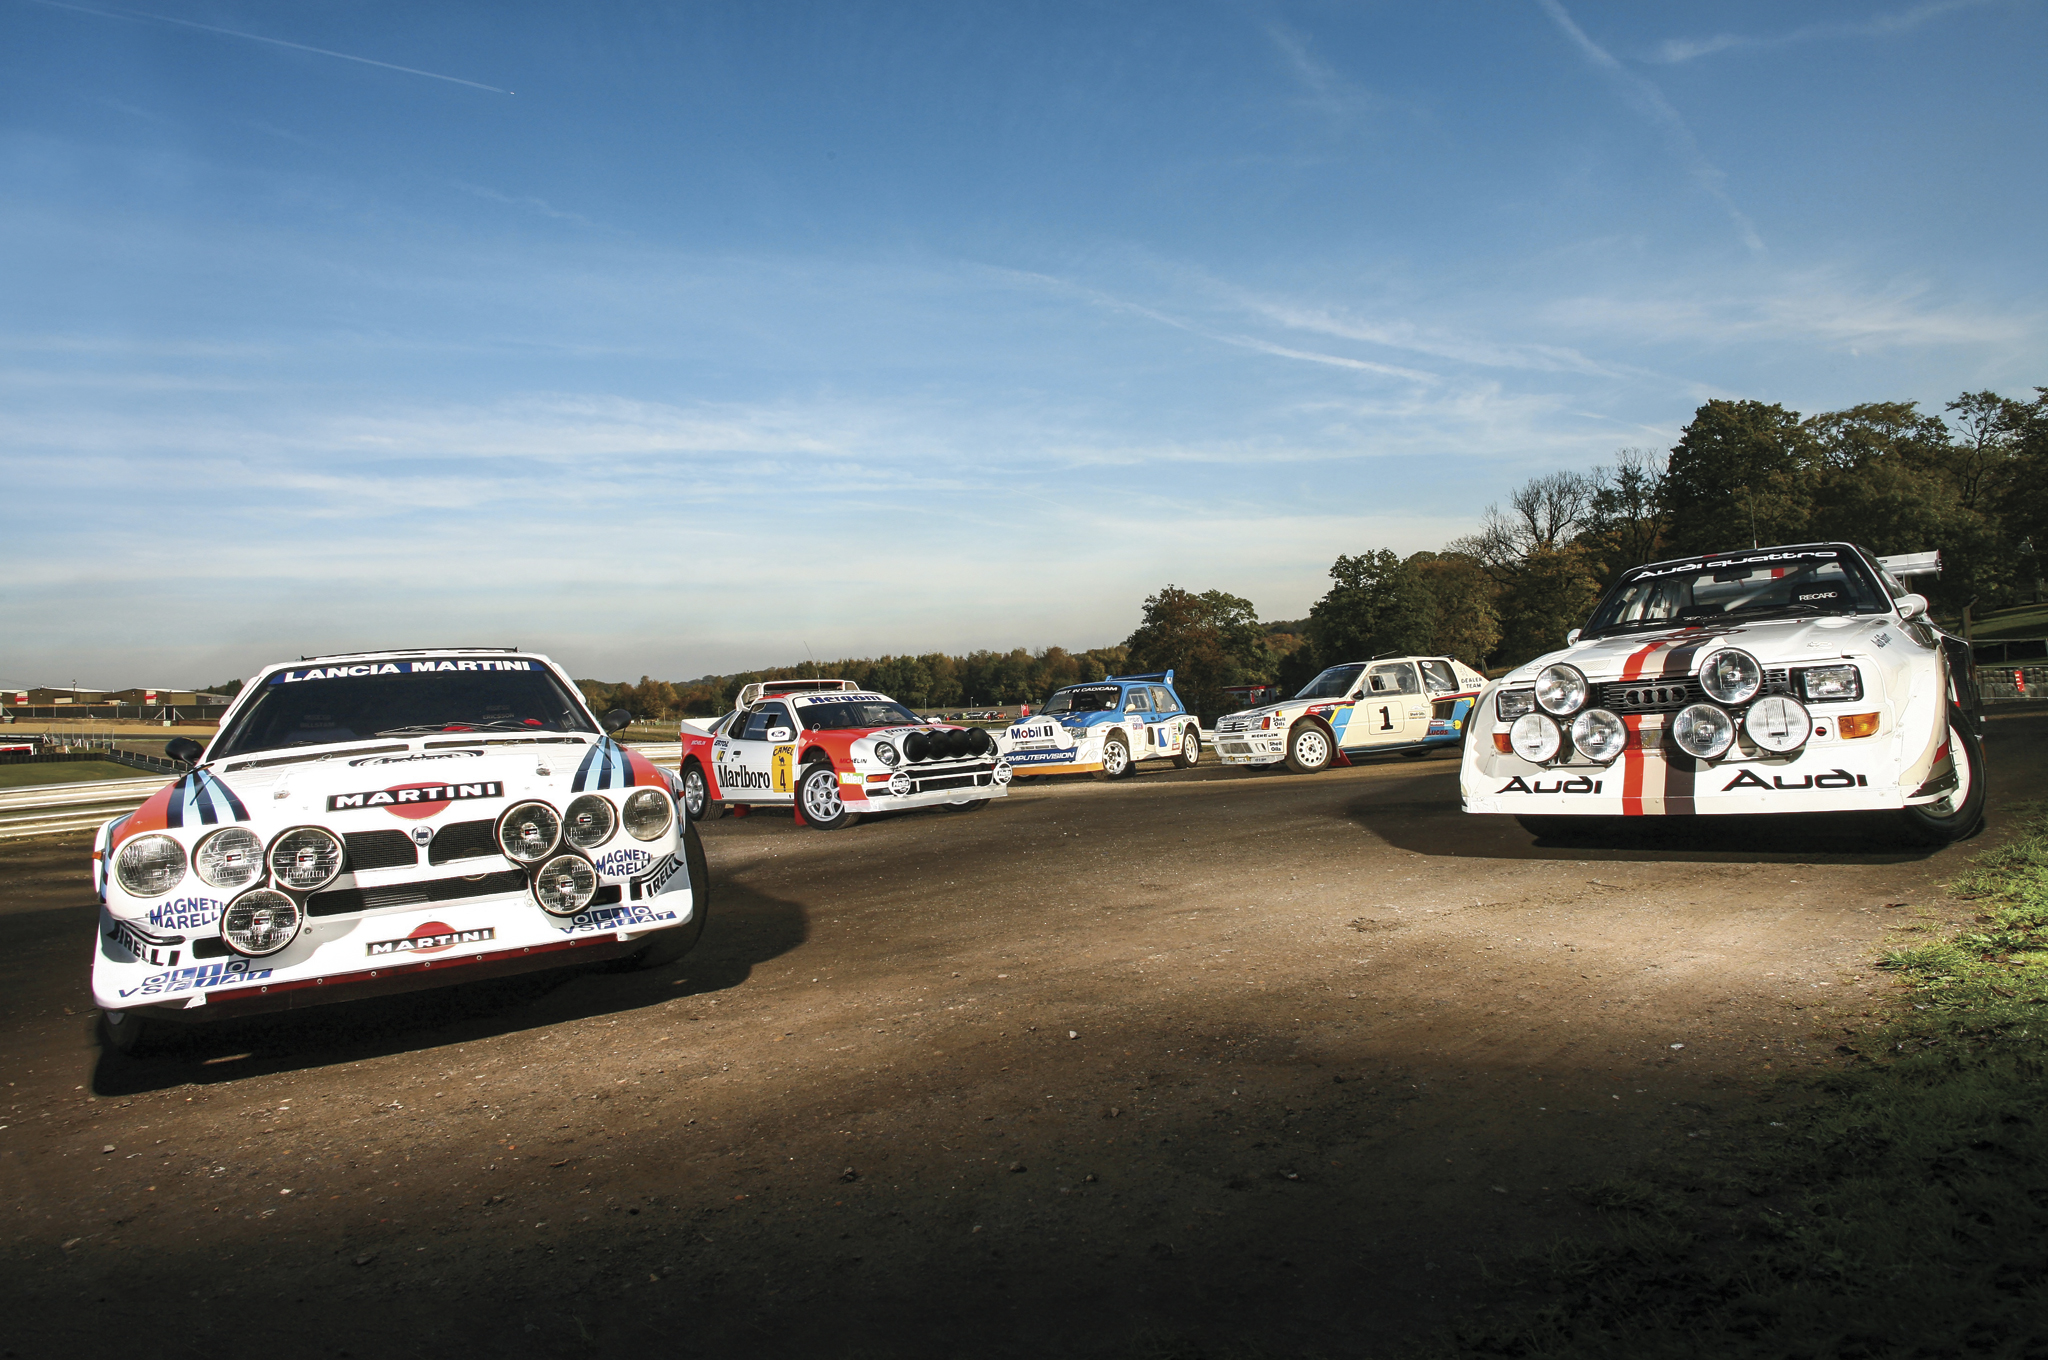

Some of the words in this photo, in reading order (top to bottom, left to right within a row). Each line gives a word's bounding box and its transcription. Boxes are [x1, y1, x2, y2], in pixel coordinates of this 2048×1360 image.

[1631, 563, 1703, 582] Audi
[1706, 551, 1838, 567] quattro
[1799, 591, 1838, 601] RECARO
[284, 663, 401, 683] LANCIA
[411, 660, 531, 672] MARTINI
[1379, 706, 1394, 730] 1
[1011, 727, 1042, 739] Mobil
[1045, 726, 1053, 737] 1
[773, 746, 794, 756] CAMEL
[1004, 752, 1075, 762] OMPUTERVISION
[717, 765, 771, 789] Marlboro
[779, 769, 787, 792] 4
[841, 773, 863, 784] Valeo
[1494, 776, 1603, 794] Audi
[1720, 769, 1869, 792] Audi
[335, 782, 496, 808] MARTINI
[595, 849, 654, 865] MAGNETI
[571, 906, 653, 926] OLIO
[372, 930, 490, 955] MARTINI
[141, 959, 251, 987] OLIO
